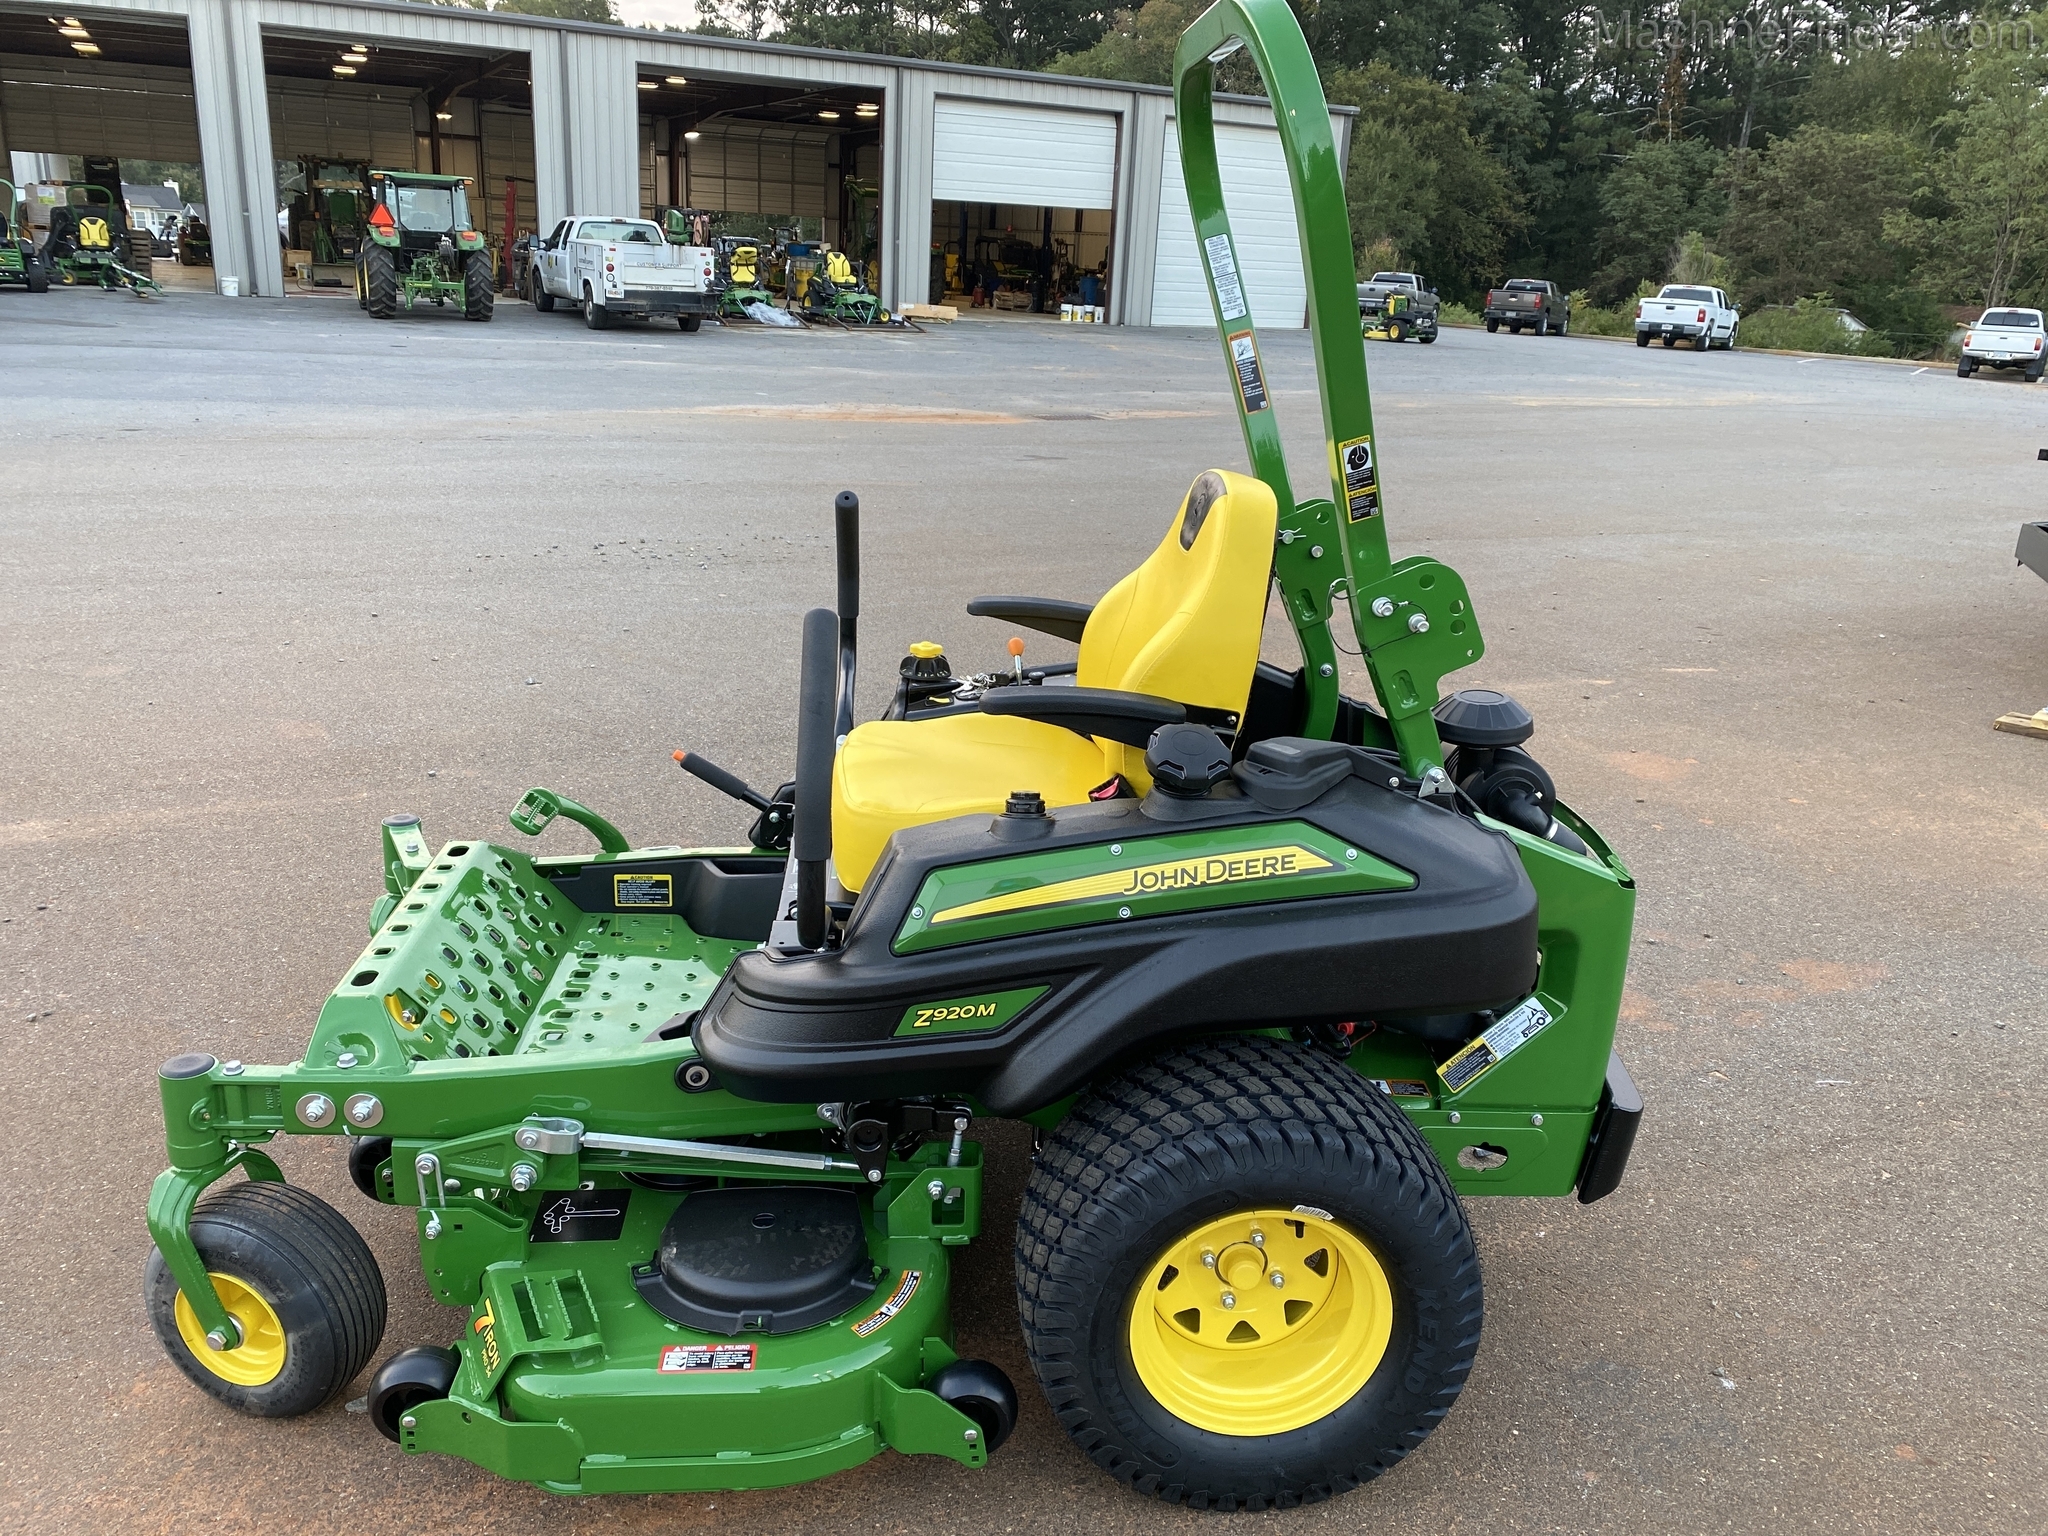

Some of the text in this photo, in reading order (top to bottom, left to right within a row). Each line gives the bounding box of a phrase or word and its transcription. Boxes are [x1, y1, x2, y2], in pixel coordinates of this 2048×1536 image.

[1347, 436, 1369, 446] CAUTION
[1123, 854, 1297, 893] JOHN DEERE
[913, 1003, 996, 1027] Z920M
[1450, 1044, 1476, 1065] ATENCIÓN
[483, 1323, 500, 1370] IRON
[1383, 1287, 1442, 1414] KENDA
